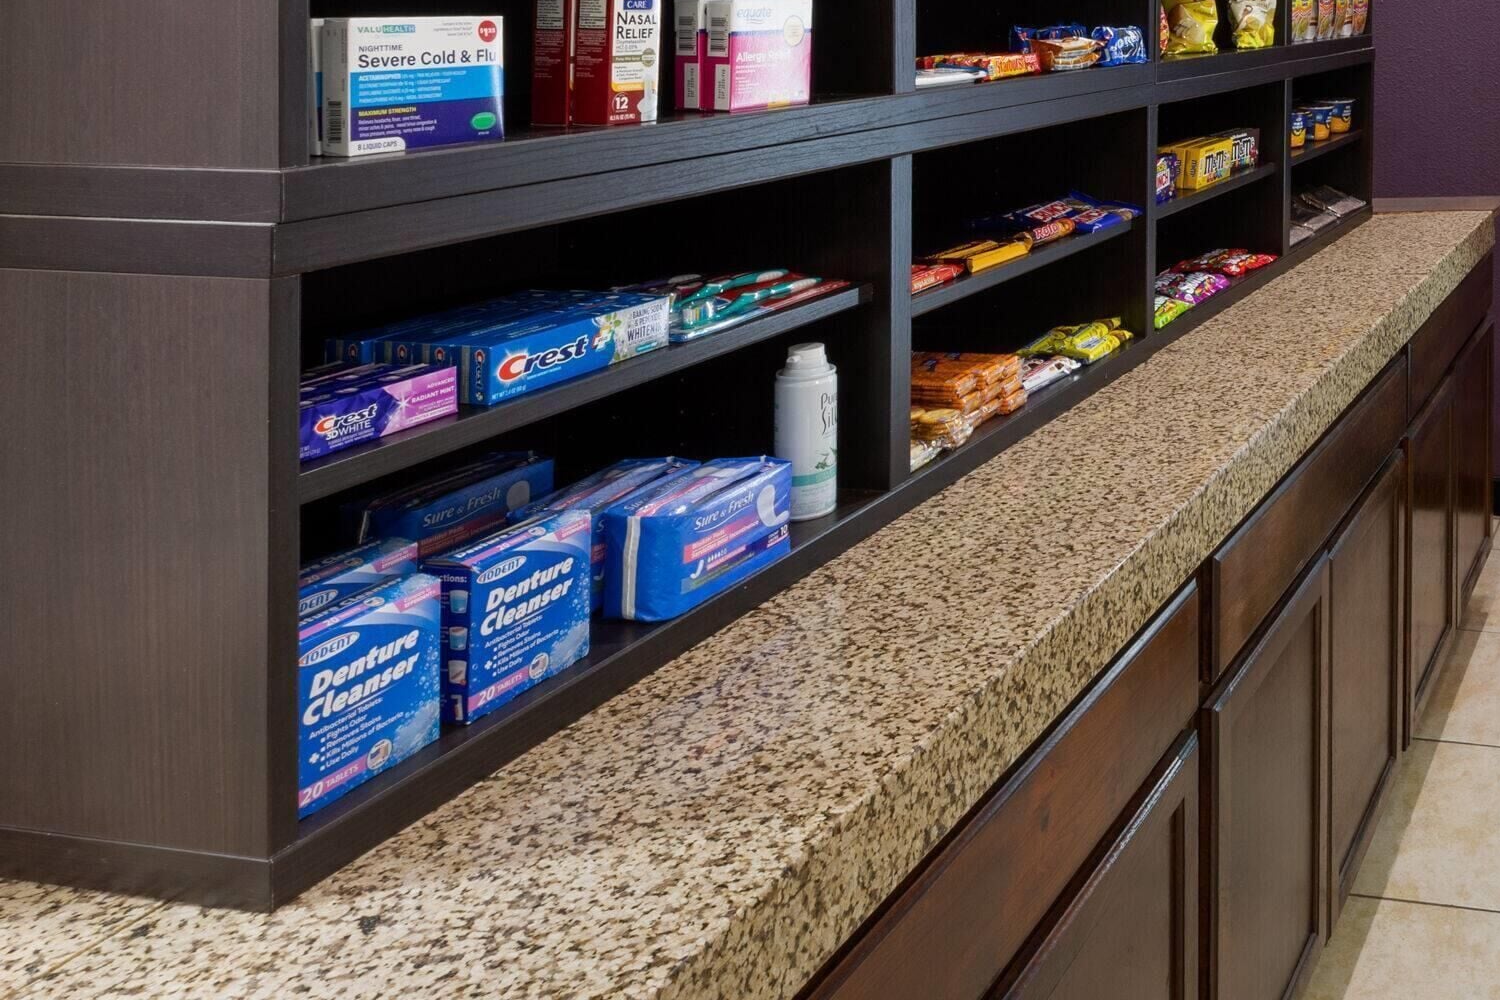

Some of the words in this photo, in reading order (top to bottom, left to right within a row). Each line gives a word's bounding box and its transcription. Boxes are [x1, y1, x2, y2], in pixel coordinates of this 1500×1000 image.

[627, 0, 647, 9] CARE
[736, 7, 773, 20] equate
[616, 12, 657, 26] NASAL
[616, 26, 653, 39] RELIEF
[358, 44, 403, 53] NIGHTTIME
[736, 51, 765, 63] Allergy
[358, 54, 416, 69] Severe
[421, 50, 455, 66] Cold
[460, 50, 471, 62] &
[476, 49, 496, 62] Flu
[358, 108, 387, 118] MAXIMUM
[388, 106, 417, 116] STRENGTH
[616, 96, 629, 109] 12
[363, 141, 382, 150] LIQUID
[383, 140, 397, 149] CAPS
[1033, 223, 1060, 240] Rolo
[632, 308, 650, 319] BAKING
[651, 305, 663, 315] SODA
[498, 334, 590, 381] Crest
[427, 377, 455, 389] ADVANCED
[411, 391, 439, 403] RADIANT
[440, 385, 455, 396] MINT
[314, 403, 378, 434] Crest
[338, 420, 372, 436] WHITE
[424, 508, 455, 528] Sure
[456, 505, 465, 514] &
[467, 487, 501, 511] Fresh
[694, 512, 720, 531] Sure
[728, 491, 755, 513] Fresh
[780, 524, 788, 537] 10
[439, 575, 467, 583] ctions:
[486, 557, 574, 612] Denture
[301, 592, 332, 613] DENT
[480, 578, 573, 636] Cleanser
[484, 626, 518, 649] Antibacterial
[497, 656, 508, 666] Kills
[529, 641, 535, 650] of
[535, 628, 560, 646] Bacteria
[498, 637, 515, 649] Fights
[516, 629, 530, 640] Odor
[522, 631, 542, 644] Stains
[304, 634, 354, 664] IODENT
[309, 629, 419, 699] Denture
[497, 662, 508, 672] Use
[509, 656, 523, 668] Daily
[303, 652, 420, 726] Cleanser
[479, 685, 494, 707] 20
[496, 673, 523, 691] TABLETS
[309, 709, 357, 739] Antibacterial
[358, 697, 383, 718] Tablets:
[327, 723, 349, 740] Fights
[349, 714, 368, 729] Odor
[326, 726, 359, 750] Removes
[360, 715, 382, 734] Stains
[326, 744, 341, 758] Kills
[341, 733, 367, 750] Millions
[368, 727, 376, 740] of
[376, 711, 404, 730] Bacteria
[326, 756, 341, 769] Use
[342, 747, 359, 763] Daily
[301, 781, 324, 806] 20
[325, 764, 360, 789] TABLETS
